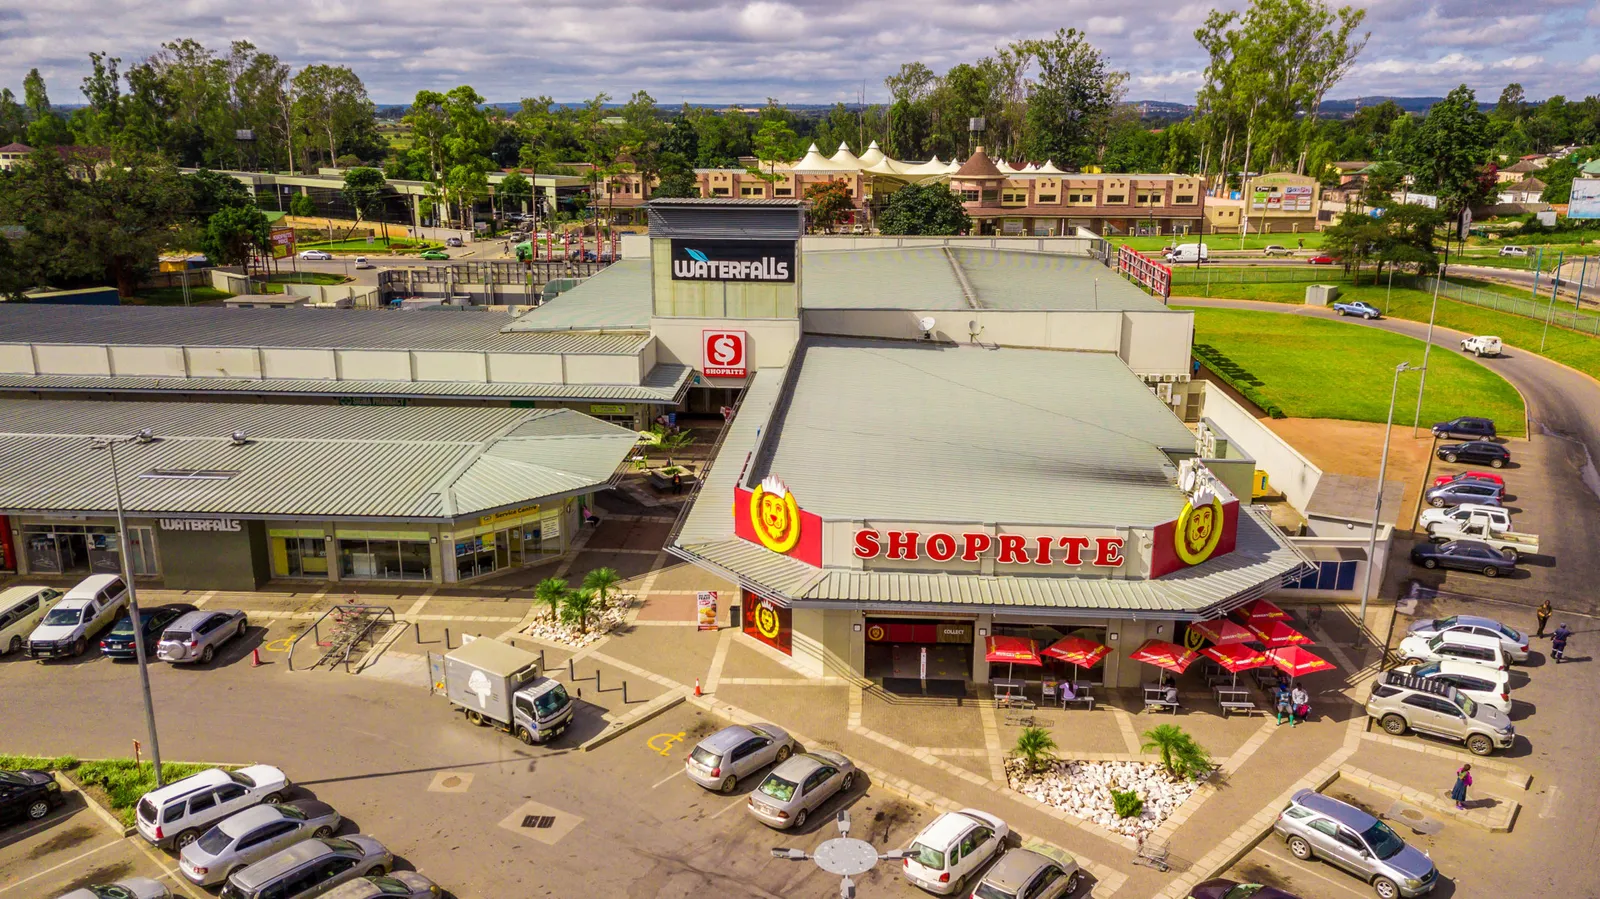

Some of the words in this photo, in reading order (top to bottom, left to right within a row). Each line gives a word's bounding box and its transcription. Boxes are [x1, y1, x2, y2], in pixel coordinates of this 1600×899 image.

[674, 257, 789, 279] WATERFALLS
[495, 510, 517, 519] Service
[517, 504, 537, 513] Centre
[160, 518, 241, 532] WATERFALLS
[853, 529, 1125, 568] SHOPRITE
